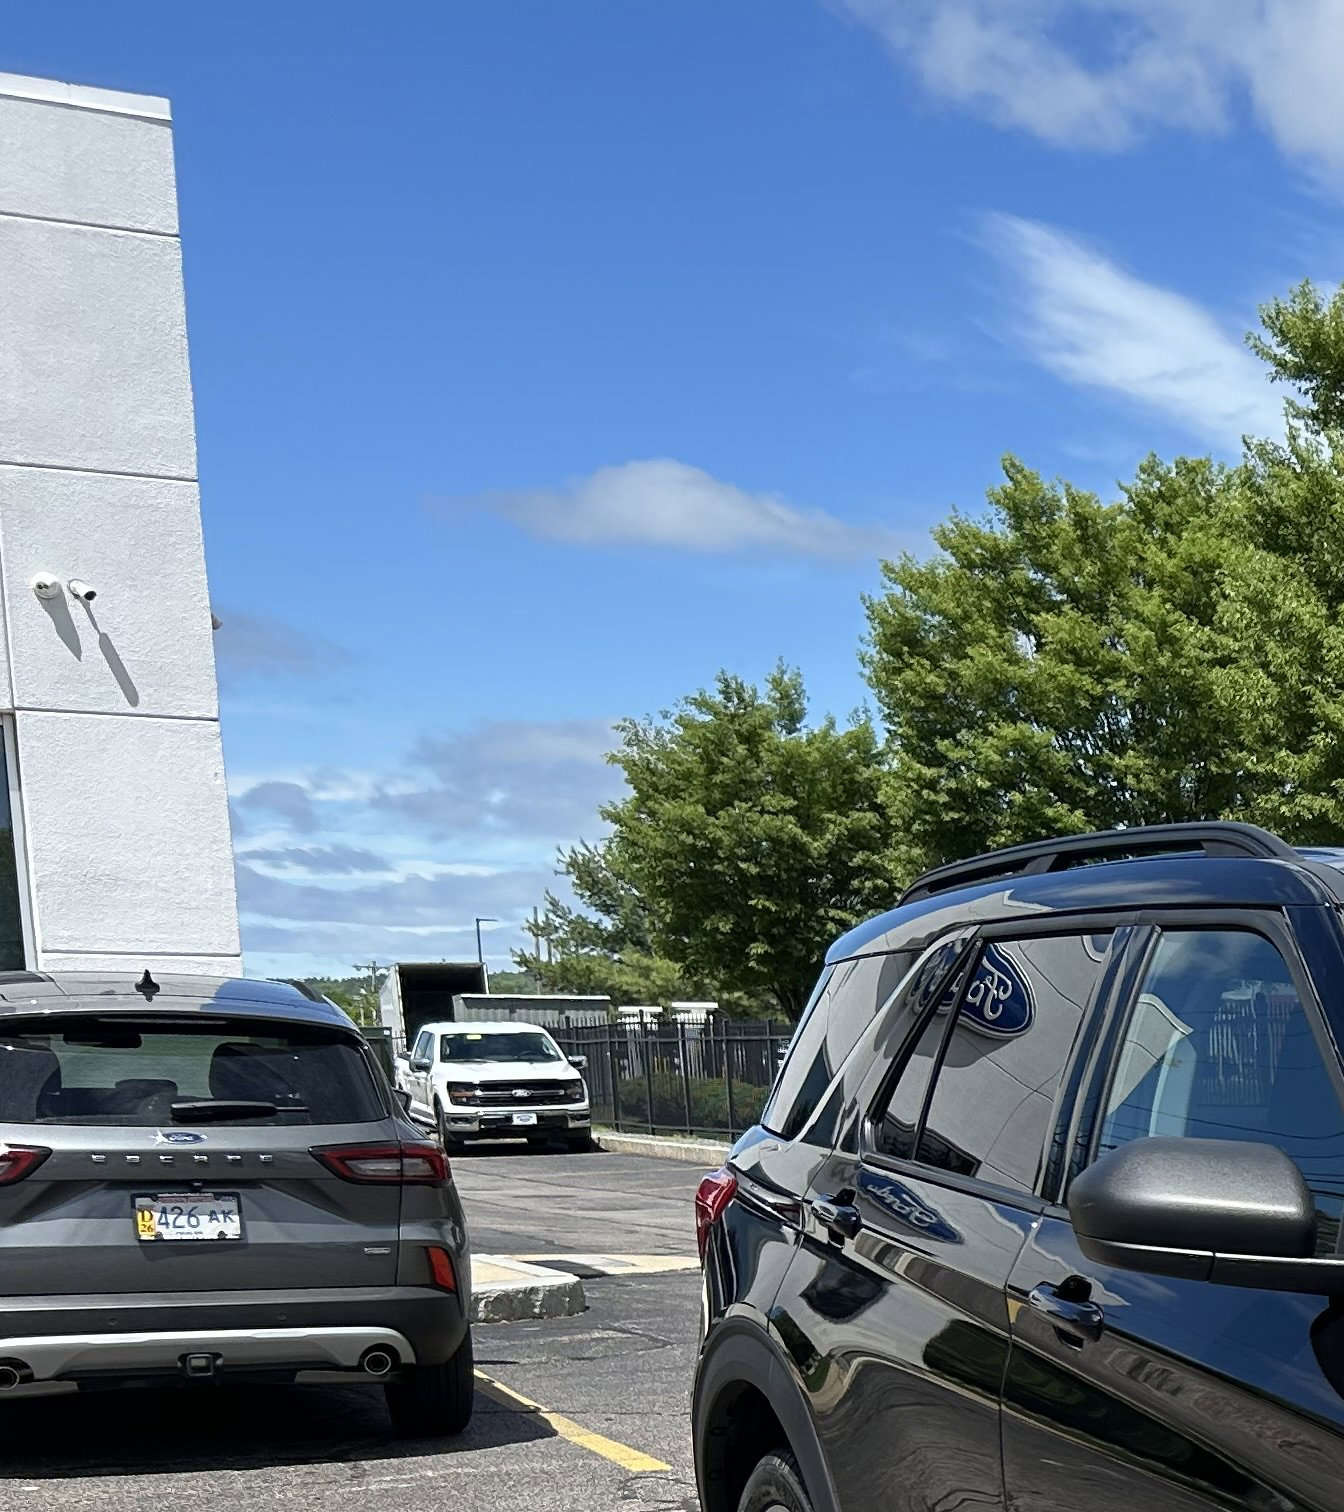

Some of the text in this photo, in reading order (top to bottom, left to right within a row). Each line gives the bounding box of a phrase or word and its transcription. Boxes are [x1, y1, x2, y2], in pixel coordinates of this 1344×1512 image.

[91, 1154, 273, 1163] ESCAPE
[157, 1205, 236, 1229] 426 AK
